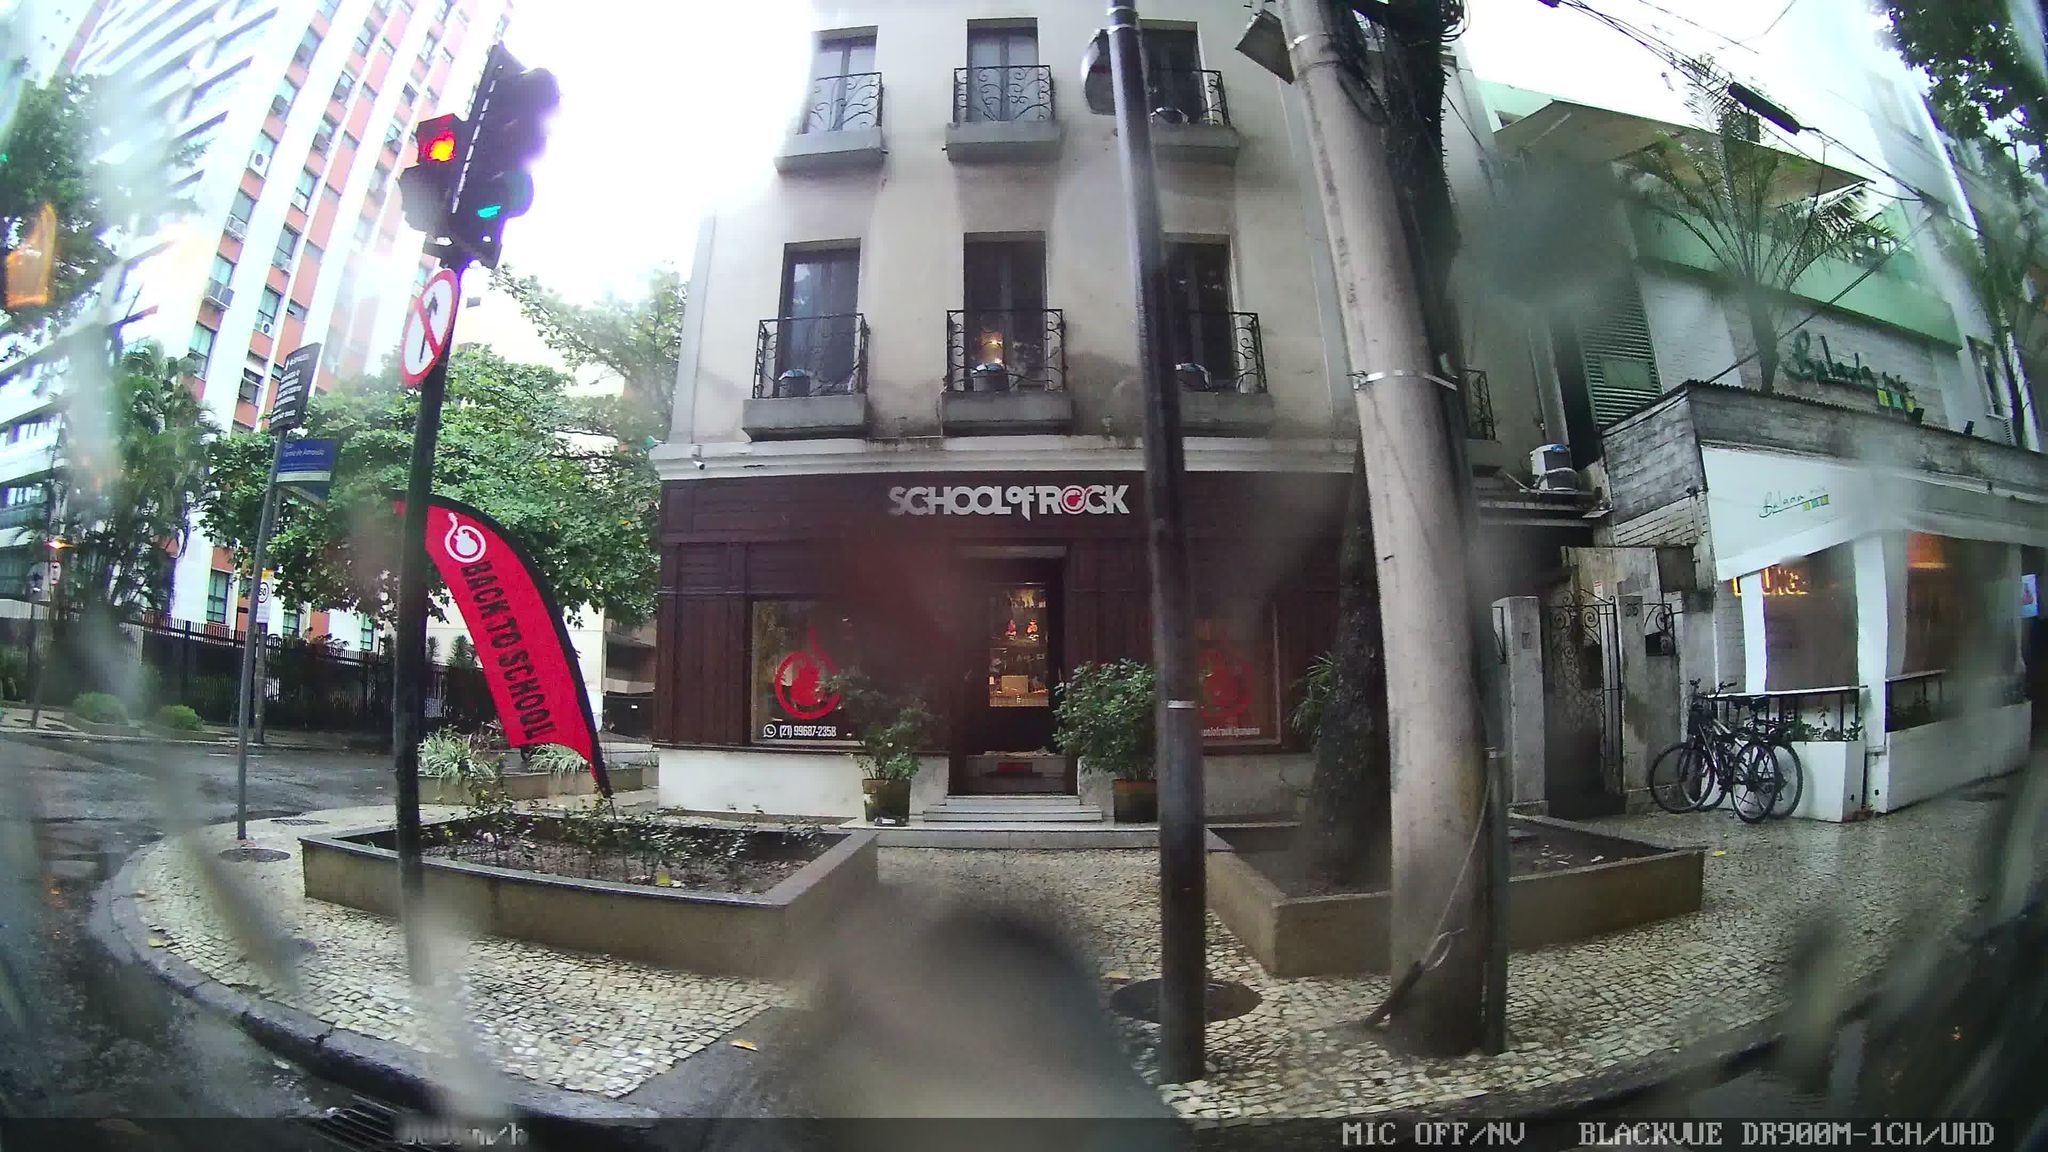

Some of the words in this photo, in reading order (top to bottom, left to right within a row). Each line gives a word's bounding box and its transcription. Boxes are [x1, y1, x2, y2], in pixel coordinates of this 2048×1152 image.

[461, 560, 512, 620] BACK
[486, 616, 523, 649] TO
[498, 649, 557, 740] SCHOOL
[779, 725, 793, 738] (21)
